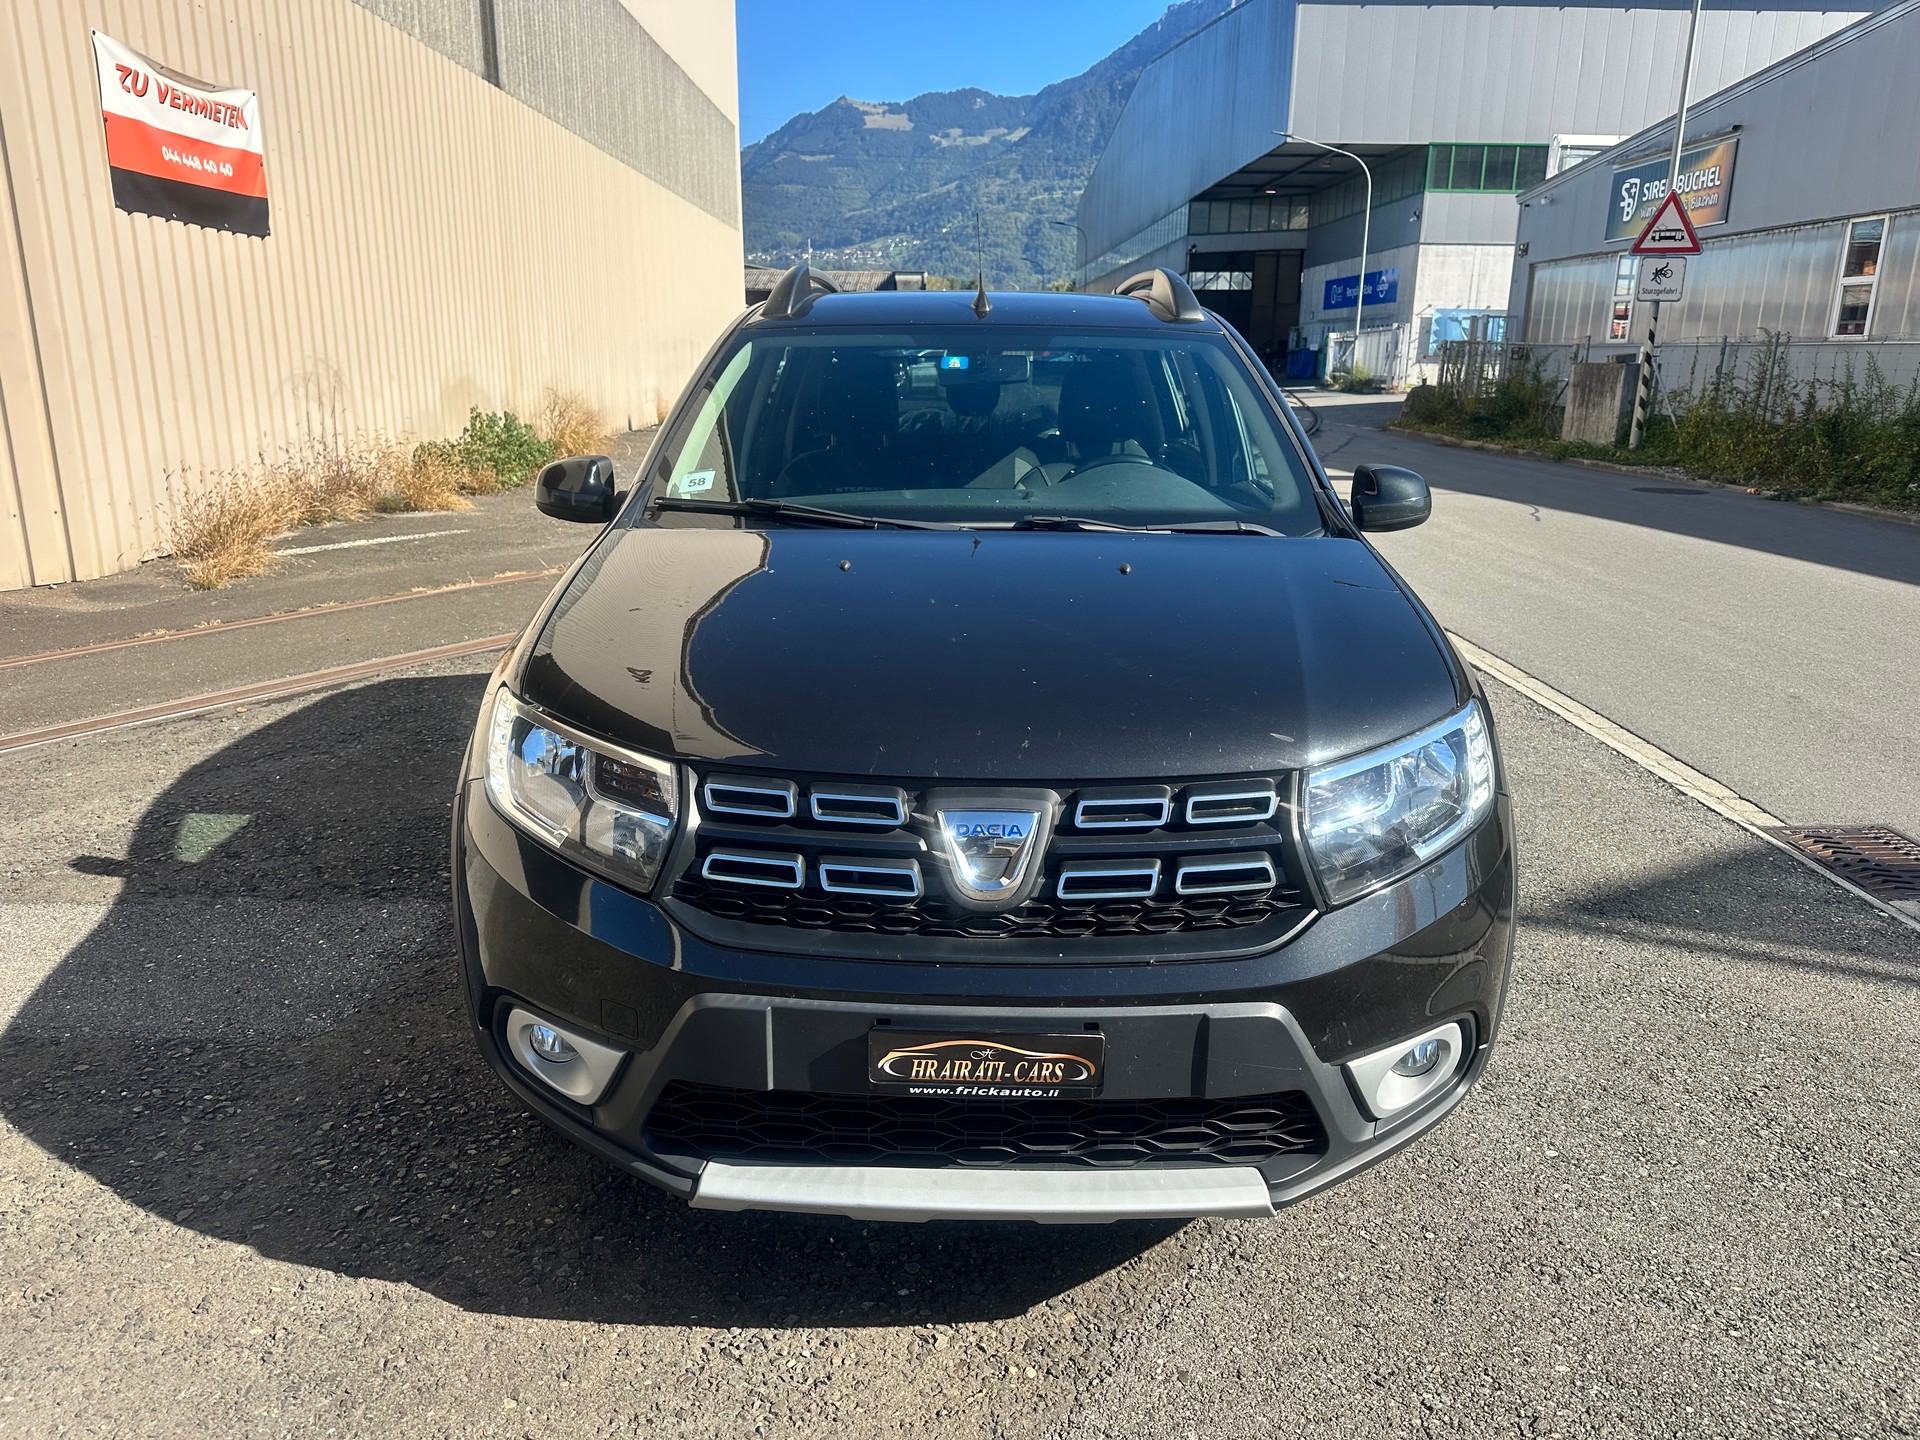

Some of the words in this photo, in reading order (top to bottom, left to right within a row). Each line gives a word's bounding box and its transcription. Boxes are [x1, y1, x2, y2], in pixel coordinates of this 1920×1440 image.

[115, 63, 149, 97] ZU
[154, 78, 249, 130] VERMIETEN
[161, 146, 182, 165] 044
[182, 153, 202, 171] 448
[203, 158, 218, 174] 40
[219, 162, 233, 177] 40
[1642, 178, 1670, 201] SIRE
[1641, 287, 1678, 297] Sturzgefahr!
[688, 477, 706, 487] 58
[956, 823, 1023, 837] DACIA
[909, 1059, 1065, 1083] HRAIRATI-CARS
[909, 1086, 1060, 1097] www.frickauto.li
